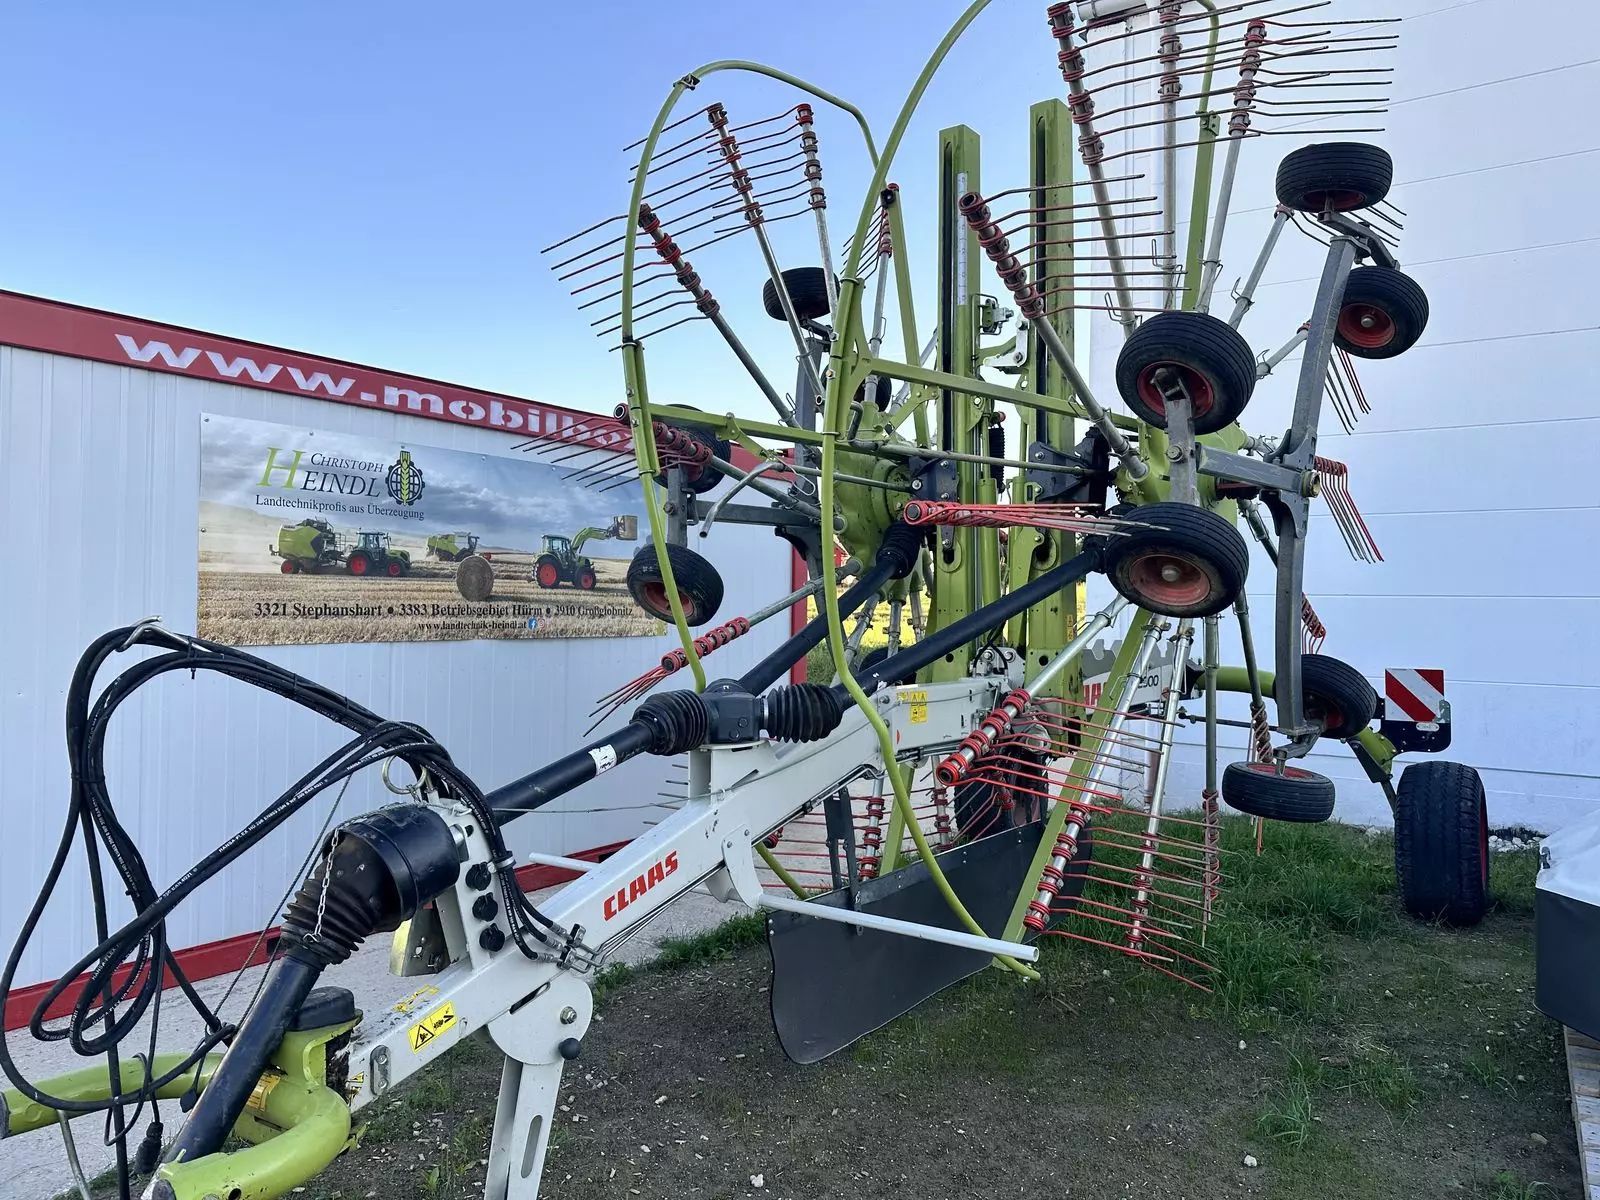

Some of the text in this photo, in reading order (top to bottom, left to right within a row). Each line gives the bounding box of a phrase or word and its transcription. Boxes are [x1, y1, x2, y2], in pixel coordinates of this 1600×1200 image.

[256, 447, 381, 498] HEINDL
[310, 452, 384, 473] CHRISTOPH
[256, 494, 425, 521] Landtechnikprofis aus Überzeugung
[254, 602, 633, 619] 3321 Stephanshart 3383 Betriebsgebiet Hürm 3910 Großglobnitz
[418, 620, 527, 631] www.landtechnik-heindl.at
[603, 850, 678, 922] CLAAS
